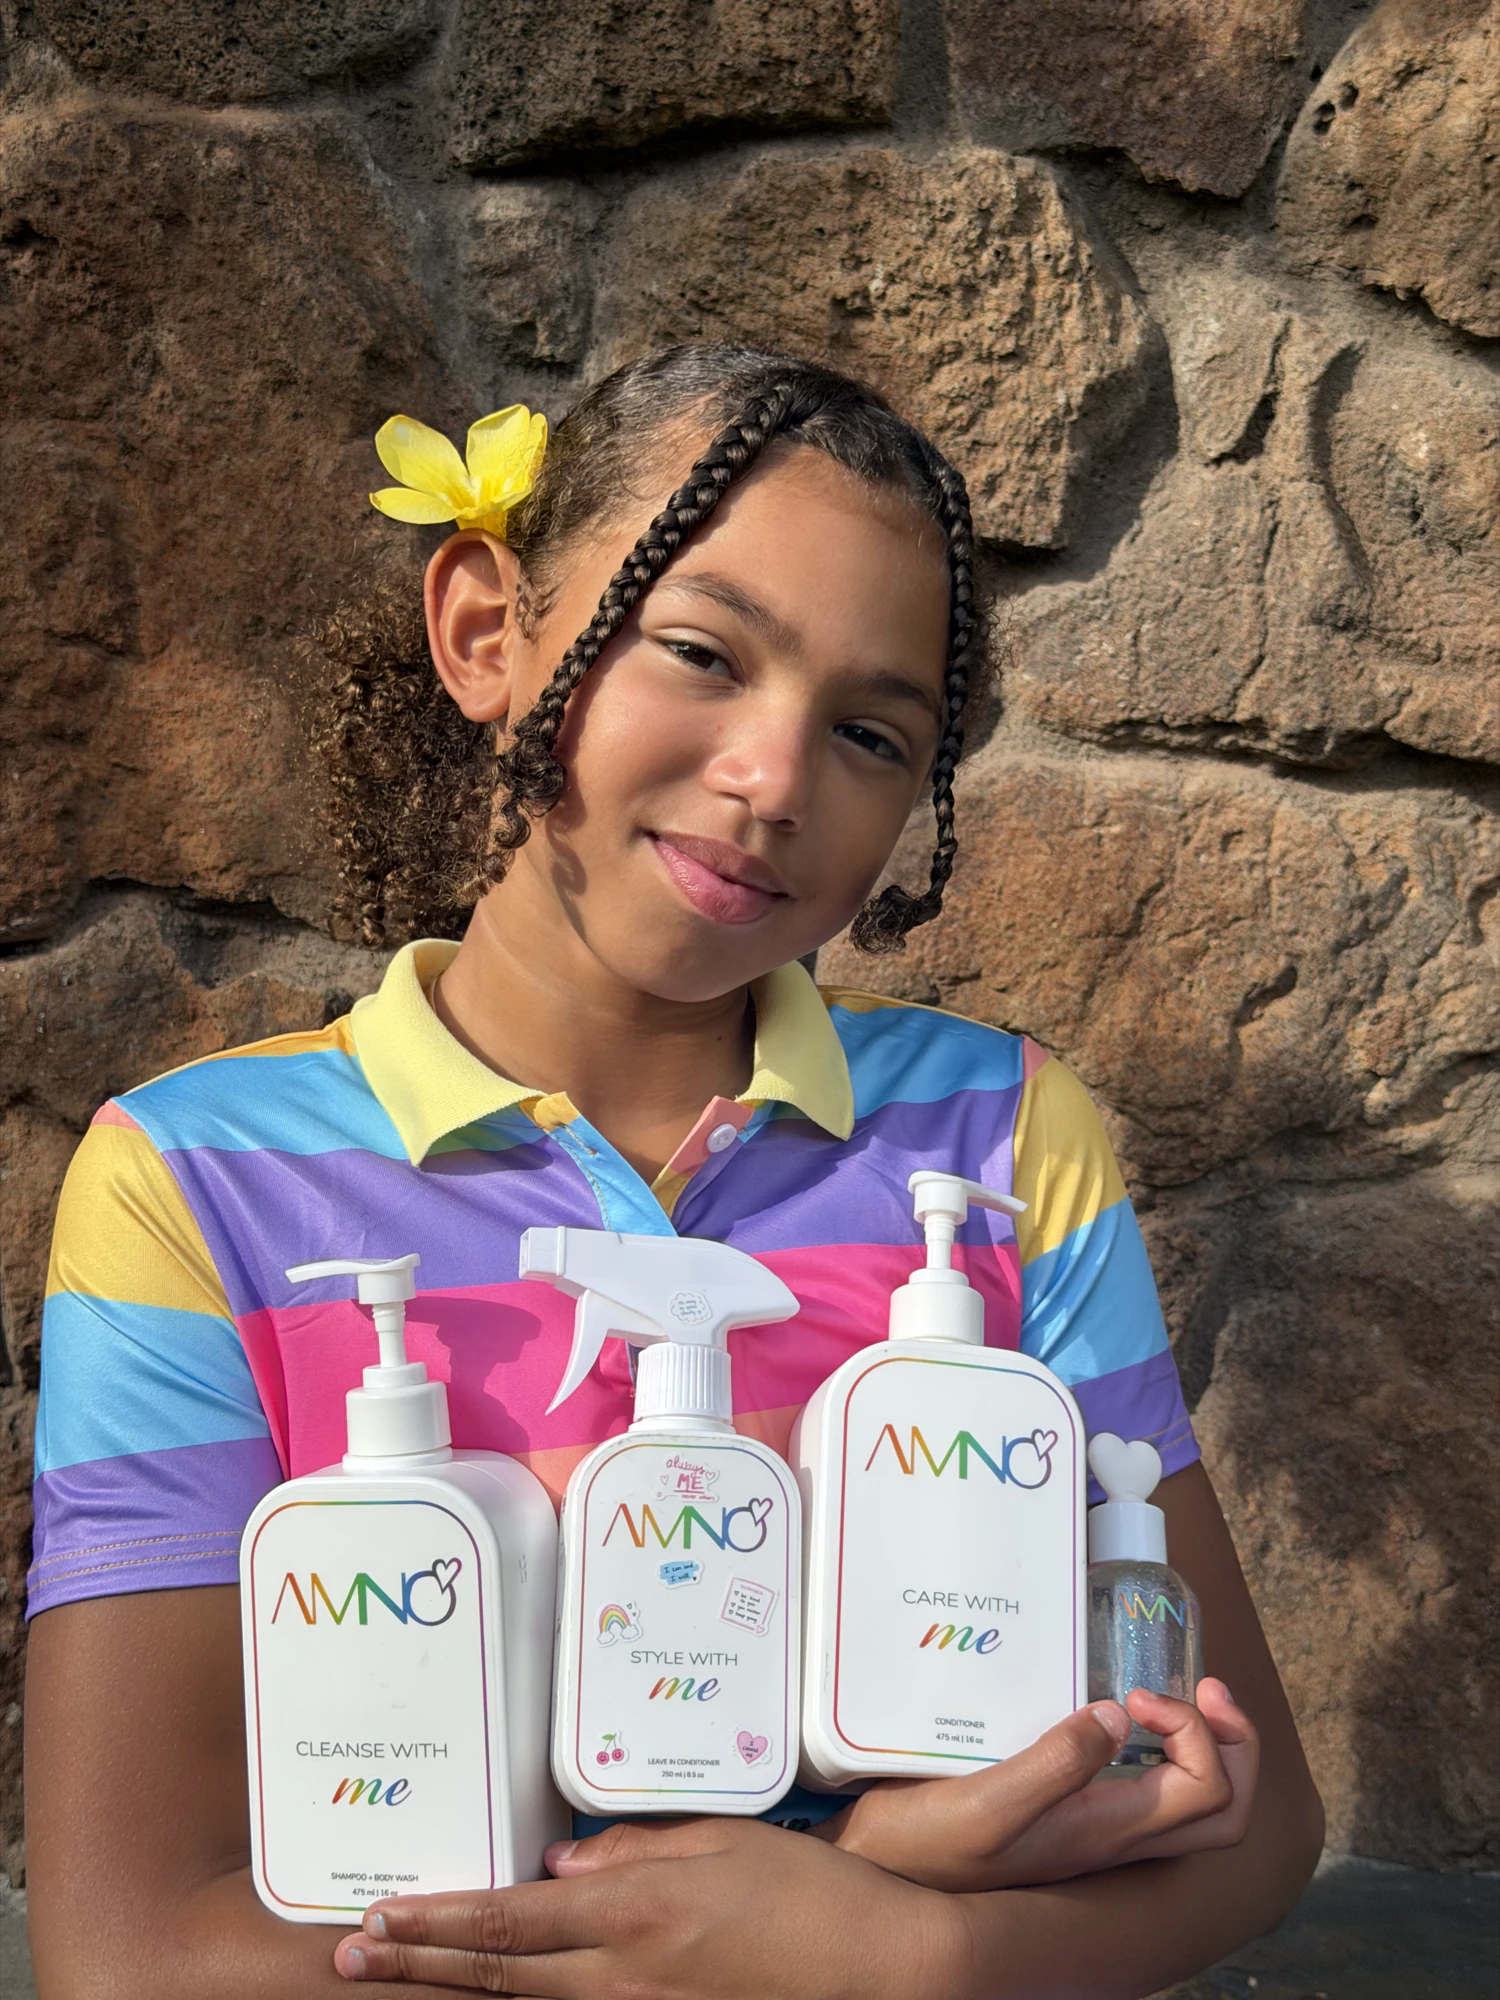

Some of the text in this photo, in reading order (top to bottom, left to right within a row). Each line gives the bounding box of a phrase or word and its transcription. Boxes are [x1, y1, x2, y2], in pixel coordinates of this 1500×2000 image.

[864, 1423, 1059, 1490] AMNO
[677, 1473, 704, 1490] ME
[602, 1497, 774, 1553] AMNO
[664, 1566, 670, 1574] I
[683, 1562, 694, 1570] and
[271, 1558, 462, 1627] AMNO
[902, 1589, 1020, 1614] CARE WITH
[918, 1622, 1003, 1655] me
[630, 1651, 738, 1666] STYLE WITH
[648, 1675, 722, 1702] me
[935, 1717, 985, 1729] CONDITIONER
[936, 1733, 950, 1741] 475
[965, 1735, 975, 1743] 16
[295, 1740, 448, 1759] CLEANSE WITH
[676, 1758, 720, 1766] CONDITIONER
[661, 1770, 674, 1778] 250
[331, 1776, 412, 1807] me
[330, 1872, 367, 1881] SHAMPOO
[374, 1873, 394, 1882] BODY
[395, 1874, 419, 1882] WASH
[352, 1888, 366, 1896] 475
[380, 1889, 390, 1897] 16
